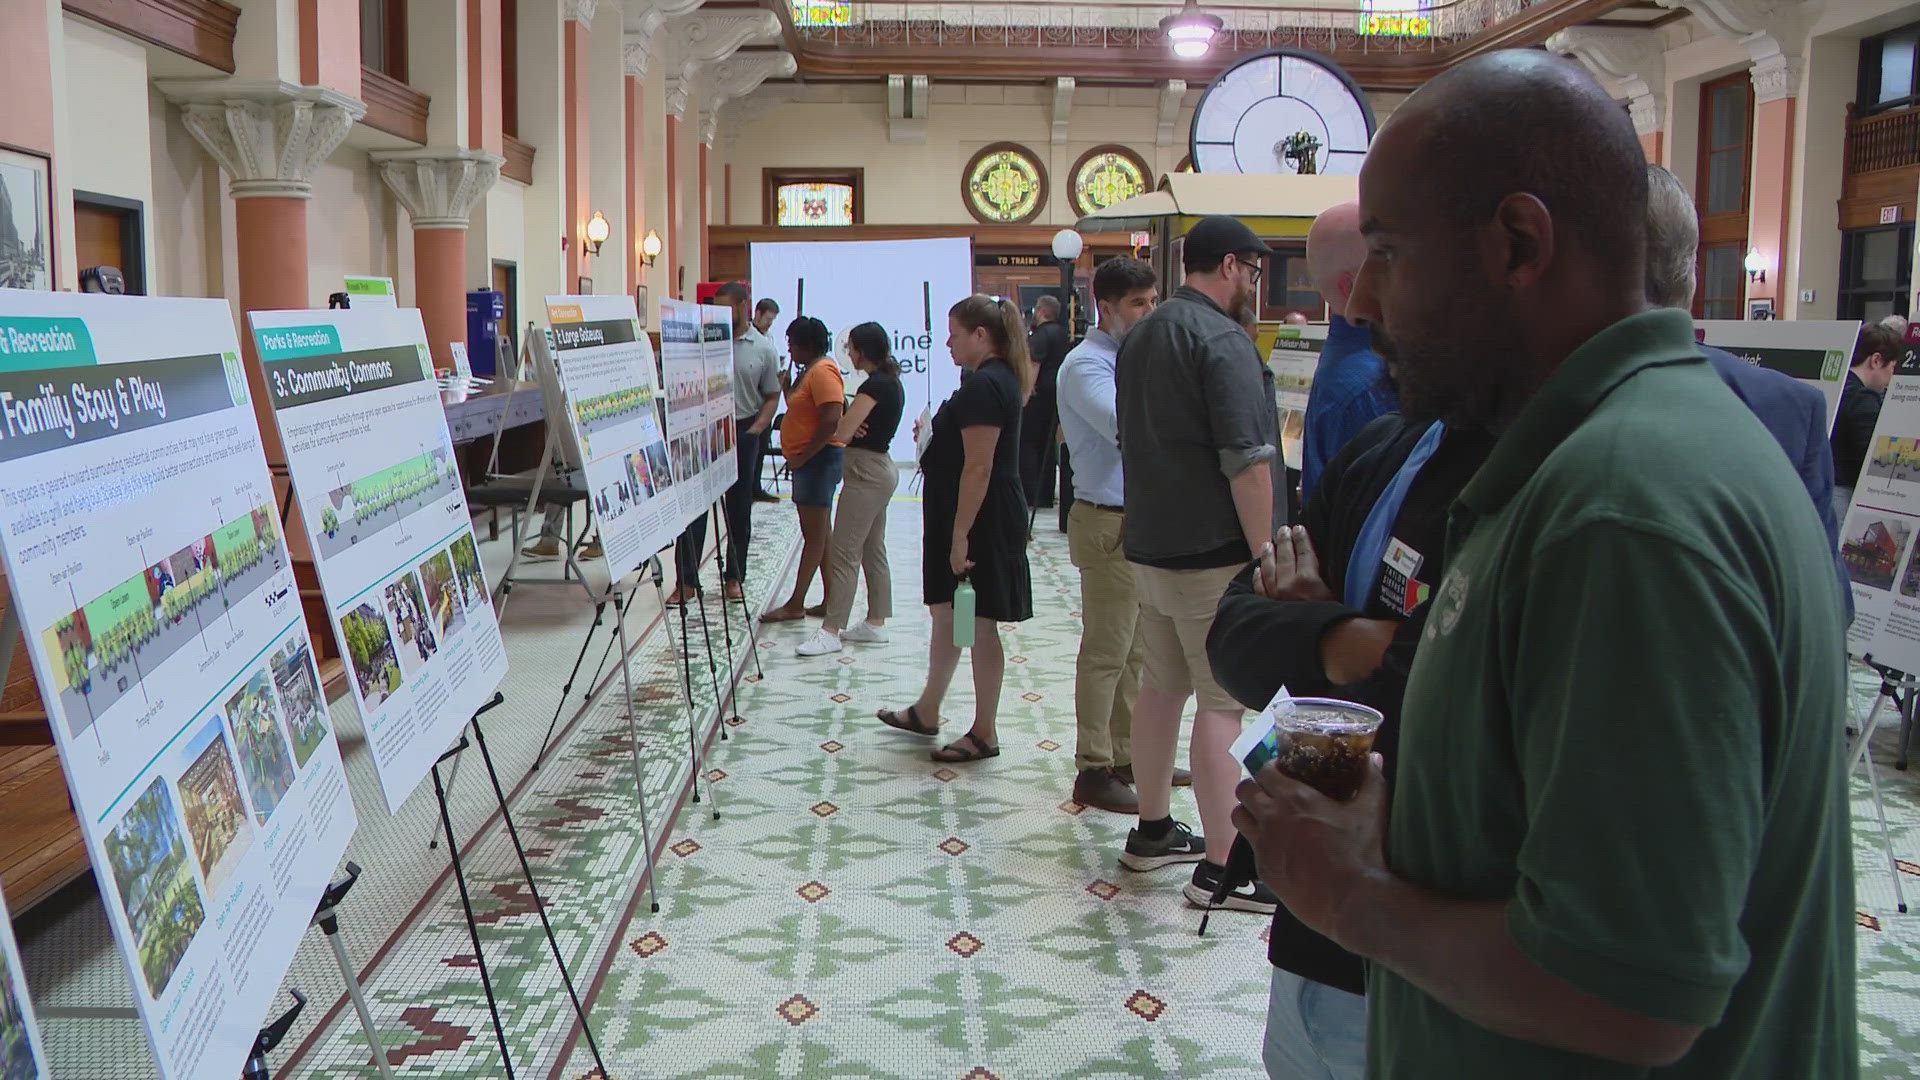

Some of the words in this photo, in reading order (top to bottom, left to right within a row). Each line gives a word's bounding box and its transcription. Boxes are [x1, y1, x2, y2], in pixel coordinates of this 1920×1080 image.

[1883, 208, 1894, 222] EXIT
[998, 257, 1007, 265] TO
[1011, 257, 1039, 265] TRAINS
[8, 325, 77, 353] Recreation
[263, 333, 286, 351] Parks
[285, 332, 293, 348] &
[292, 330, 331, 348] Recreation
[561, 328, 580, 348] Large
[579, 326, 605, 345] Gateway
[1902, 350, 1917, 369] 2:
[273, 370, 289, 398] 3:
[287, 361, 352, 393] Community
[349, 360, 393, 384] Commons
[71, 382, 119, 430] Stay
[115, 377, 131, 416] &
[128, 375, 167, 419] Play
[18, 485, 38, 505] space
[46, 472, 68, 497] geared
[90, 458, 125, 478] surrounding
[124, 448, 150, 468] residential
[150, 441, 179, 459] communities
[11, 511, 41, 534] available
[63, 498, 76, 515] and
[179, 456, 205, 473] connections
[18, 535, 57, 563] community
